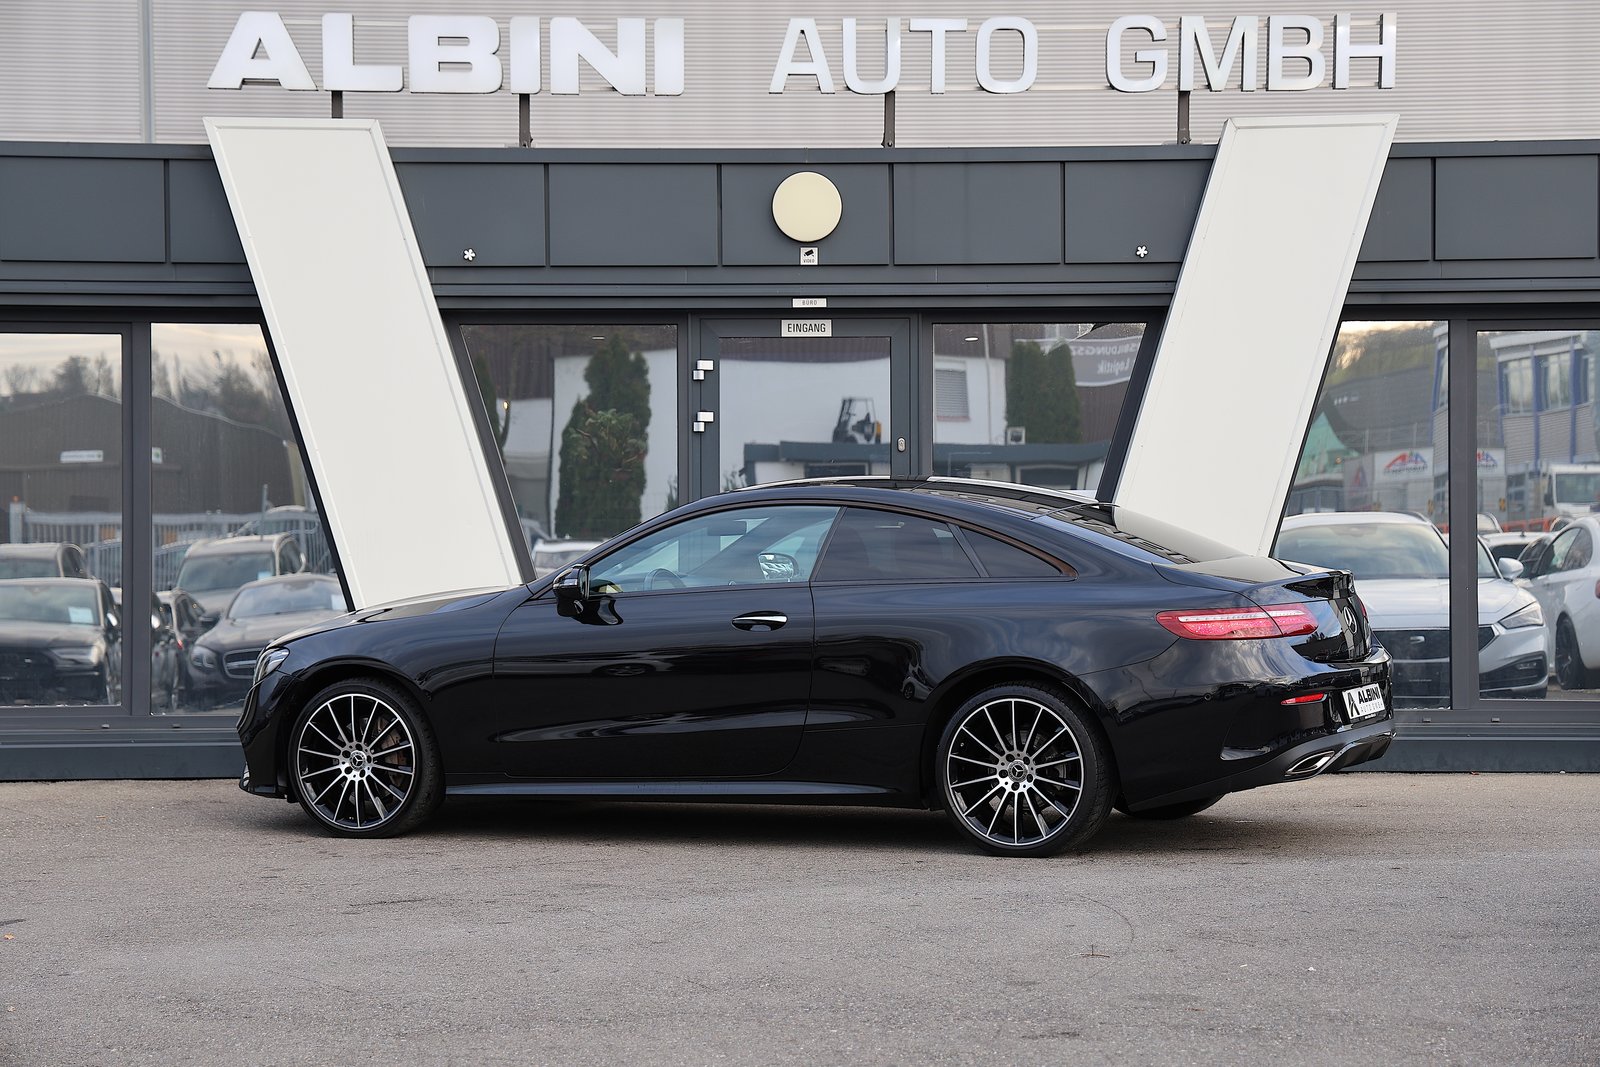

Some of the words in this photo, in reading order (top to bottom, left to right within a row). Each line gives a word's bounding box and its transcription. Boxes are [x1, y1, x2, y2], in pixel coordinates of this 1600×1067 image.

[207, 11, 685, 96] ALBINI
[769, 15, 1039, 96] AUTO
[1106, 13, 1398, 93] GMBH
[787, 323, 826, 333] EINGANG
[1358, 686, 1381, 704] ALBINI
